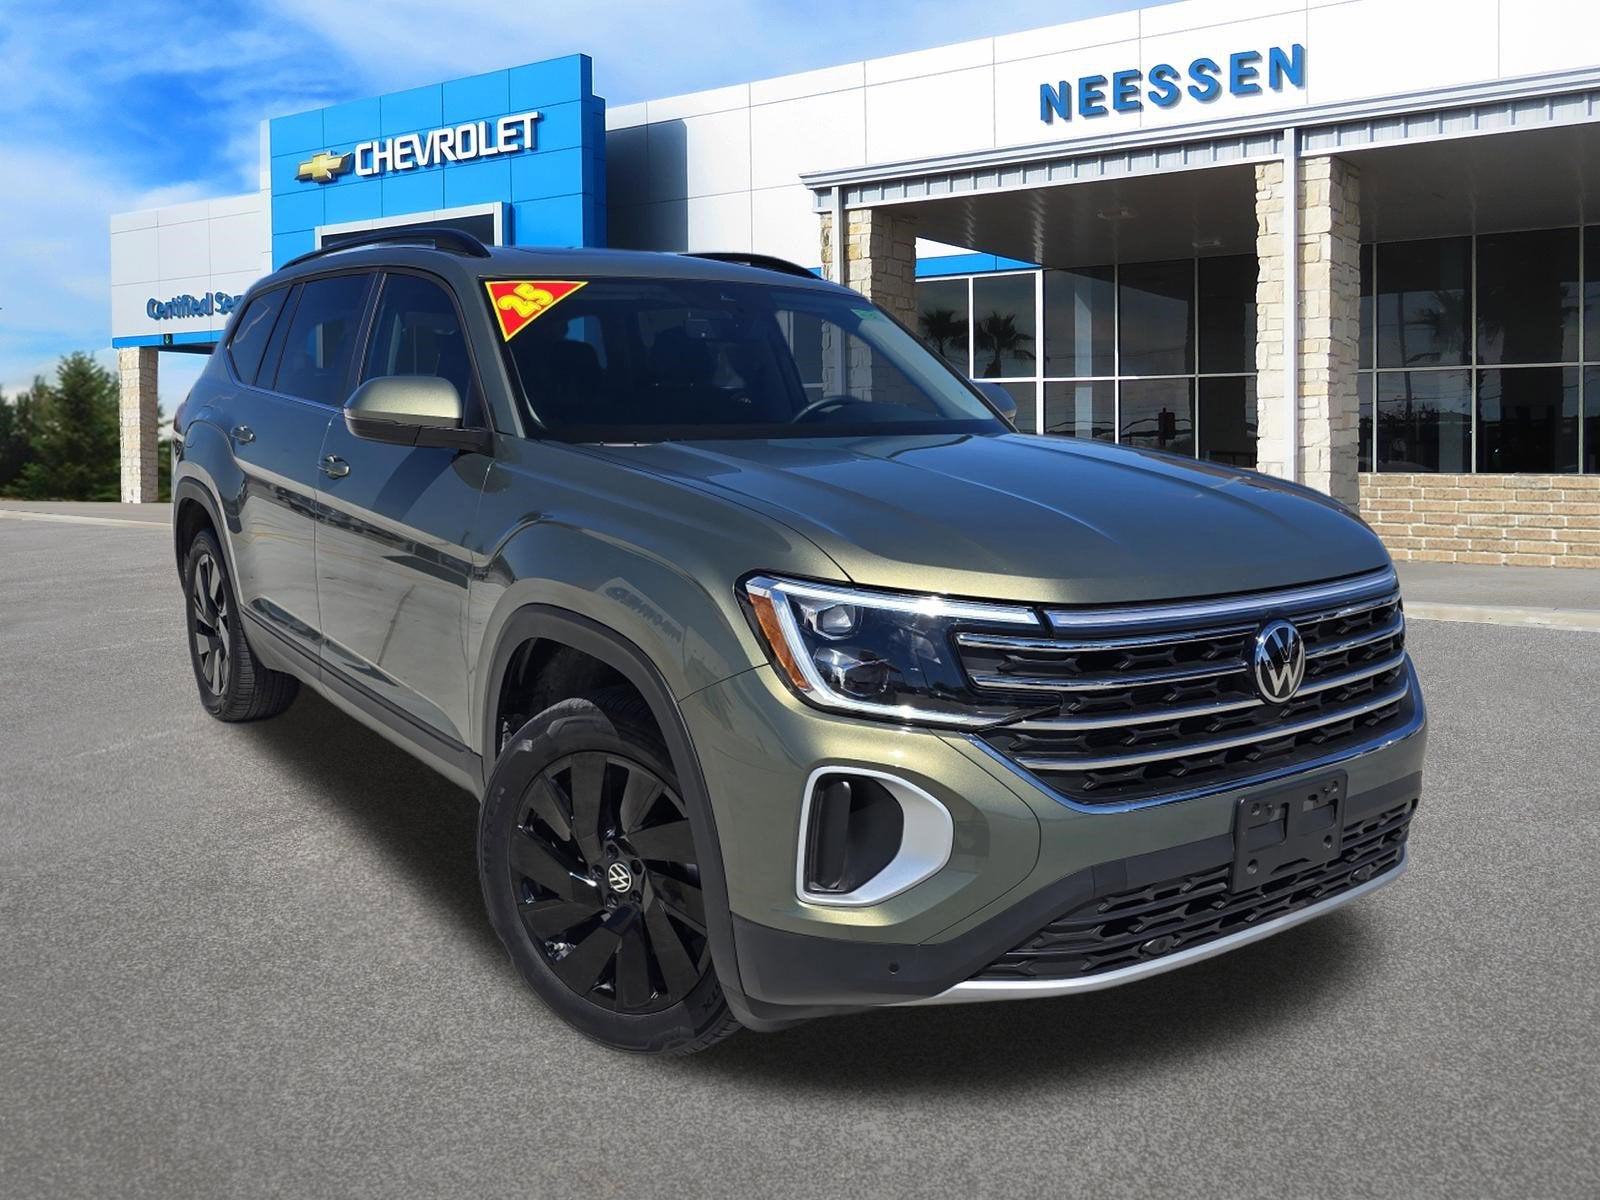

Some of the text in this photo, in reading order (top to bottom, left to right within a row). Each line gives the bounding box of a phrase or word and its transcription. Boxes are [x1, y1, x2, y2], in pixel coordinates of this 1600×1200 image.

[1040, 44, 1305, 124] NEESSEN
[354, 111, 543, 177] CHEVROLET
[146, 292, 214, 320] Certified
[497, 283, 554, 318] 25
